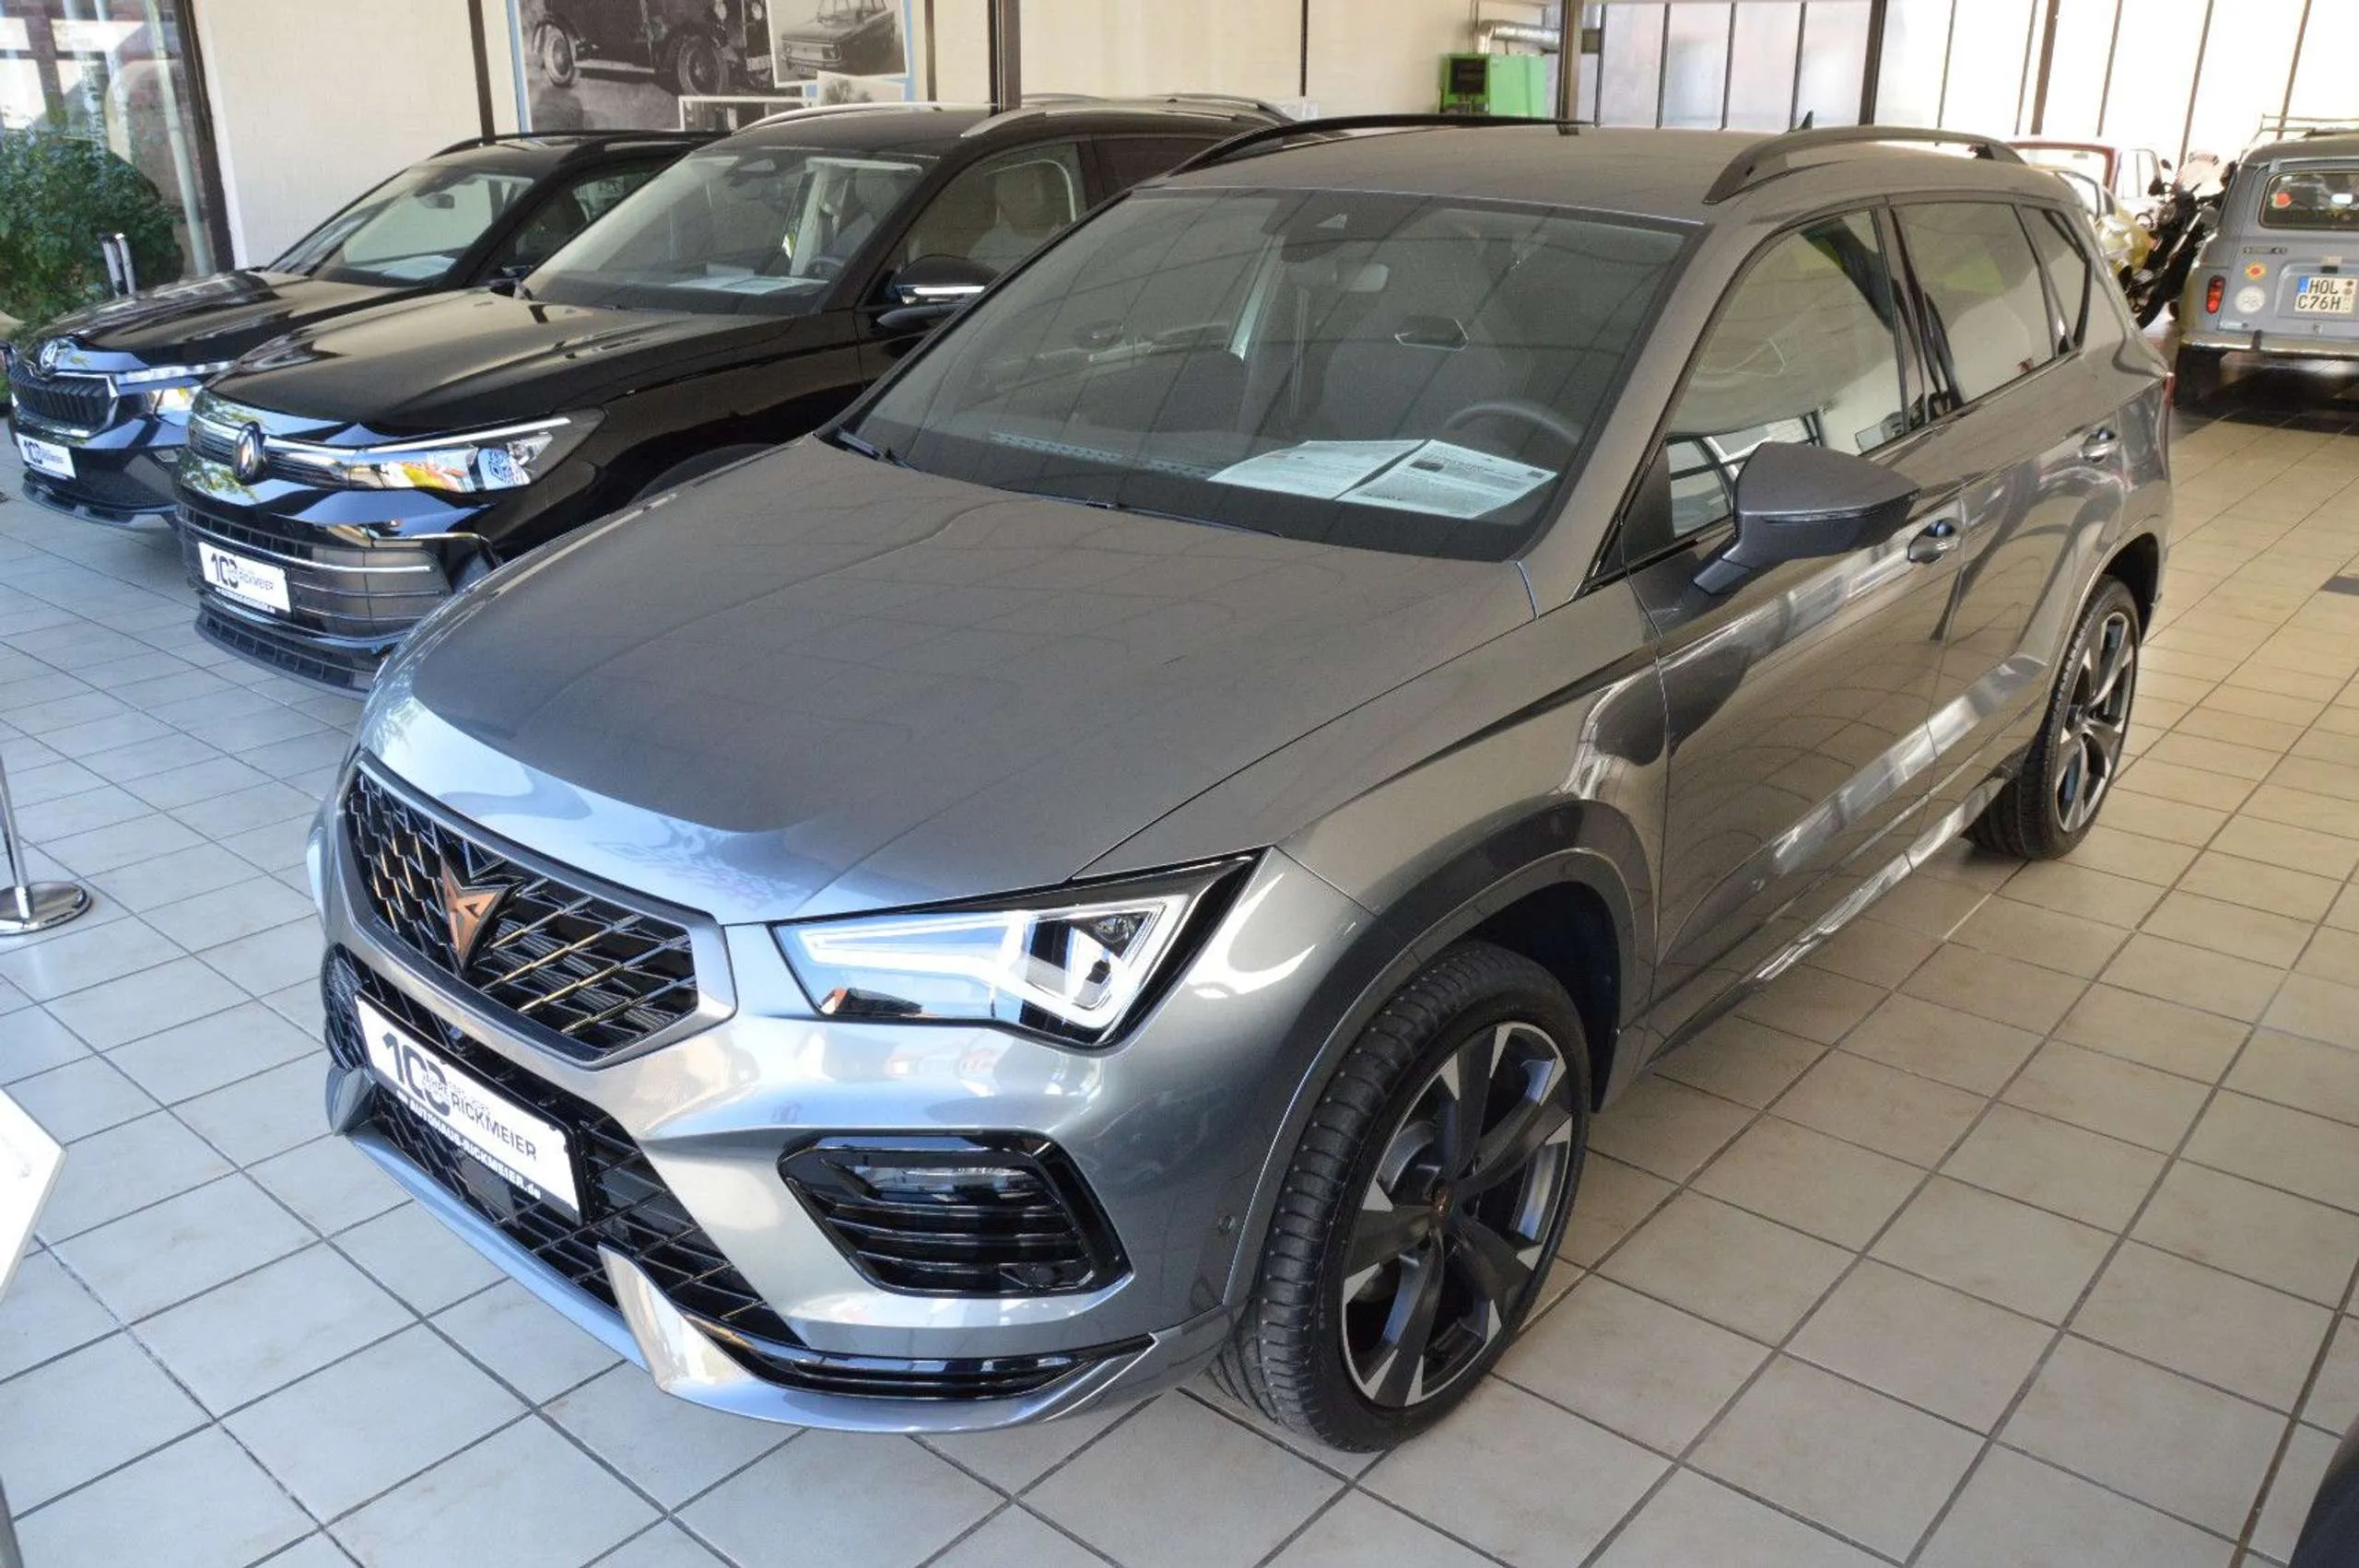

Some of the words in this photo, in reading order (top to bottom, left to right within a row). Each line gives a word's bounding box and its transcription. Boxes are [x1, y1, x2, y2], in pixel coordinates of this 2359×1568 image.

[2297, 295, 2341, 310] C76H
[2308, 279, 2339, 295] HOL
[381, 1032, 451, 1117] 100
[451, 1092, 537, 1162] RICKMEIER
